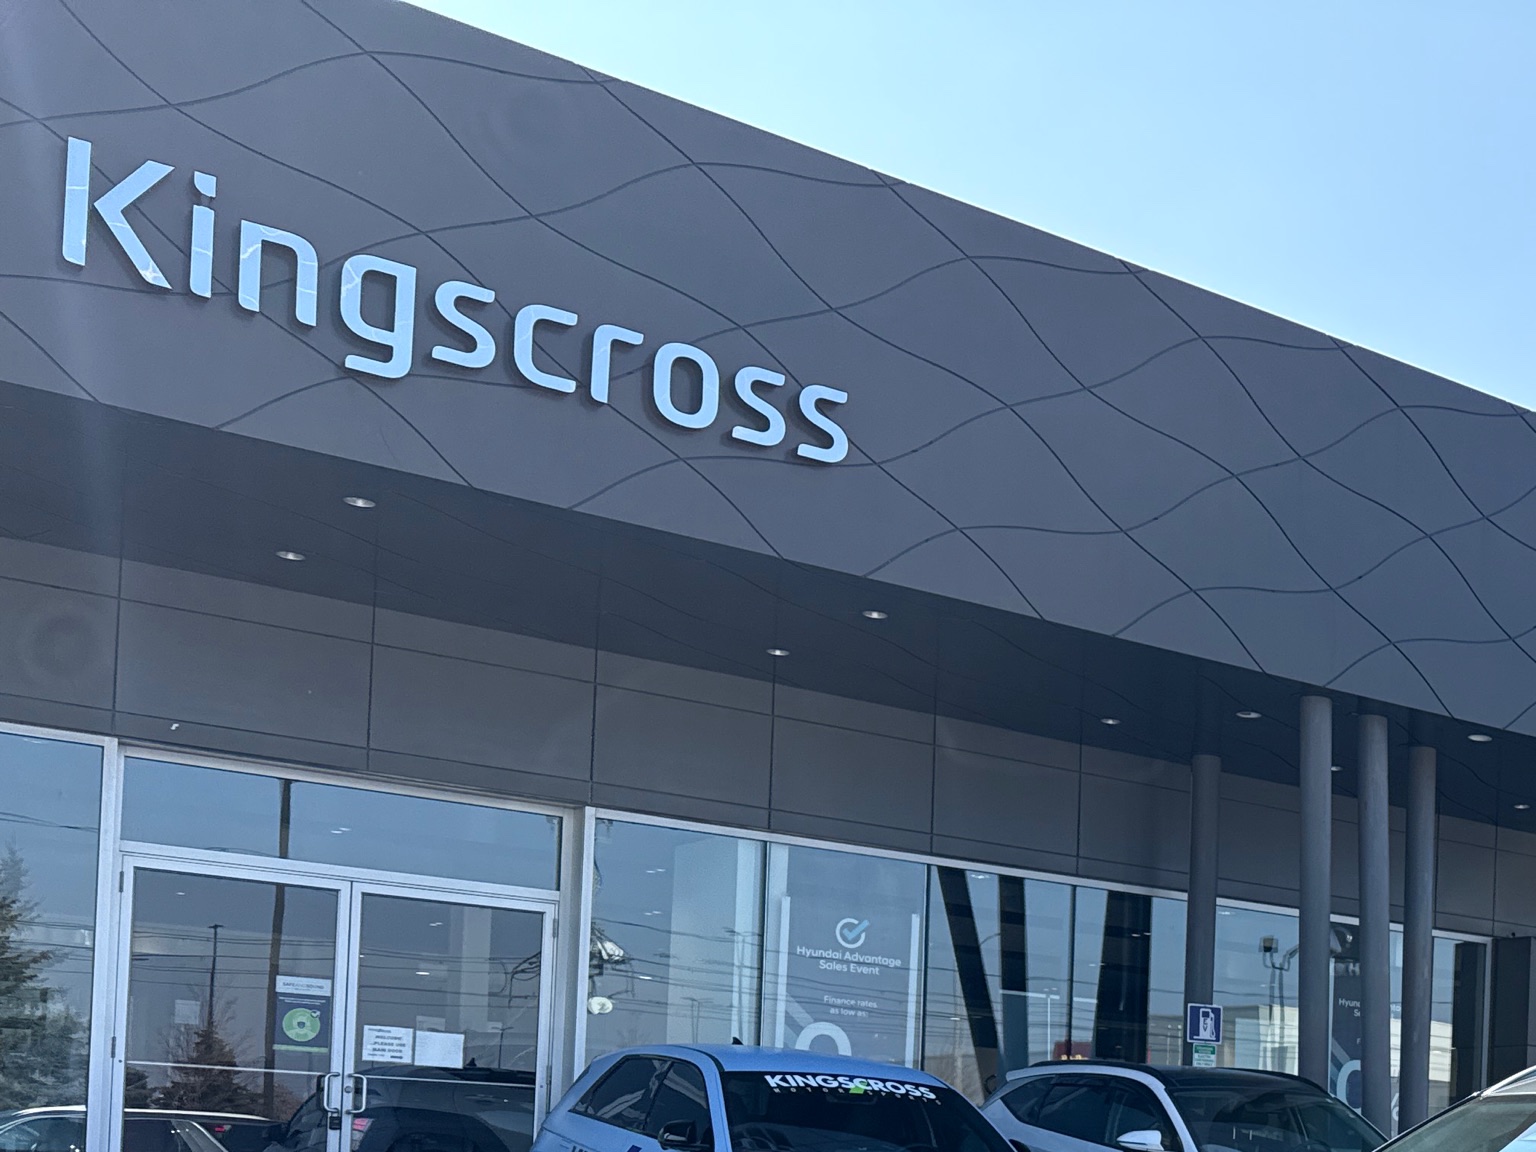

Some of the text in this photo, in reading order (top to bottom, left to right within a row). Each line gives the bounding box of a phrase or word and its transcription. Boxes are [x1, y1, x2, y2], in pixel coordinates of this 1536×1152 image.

[62, 136, 850, 464] Kingscross
[796, 945, 902, 967] Hyundai Advantage
[819, 960, 880, 975] Sales Event
[823, 995, 878, 1008] Finance rates
[1338, 998, 1360, 1008] Hyun
[841, 1008, 856, 1016] low
[764, 1074, 937, 1100] KINGSCROSS
